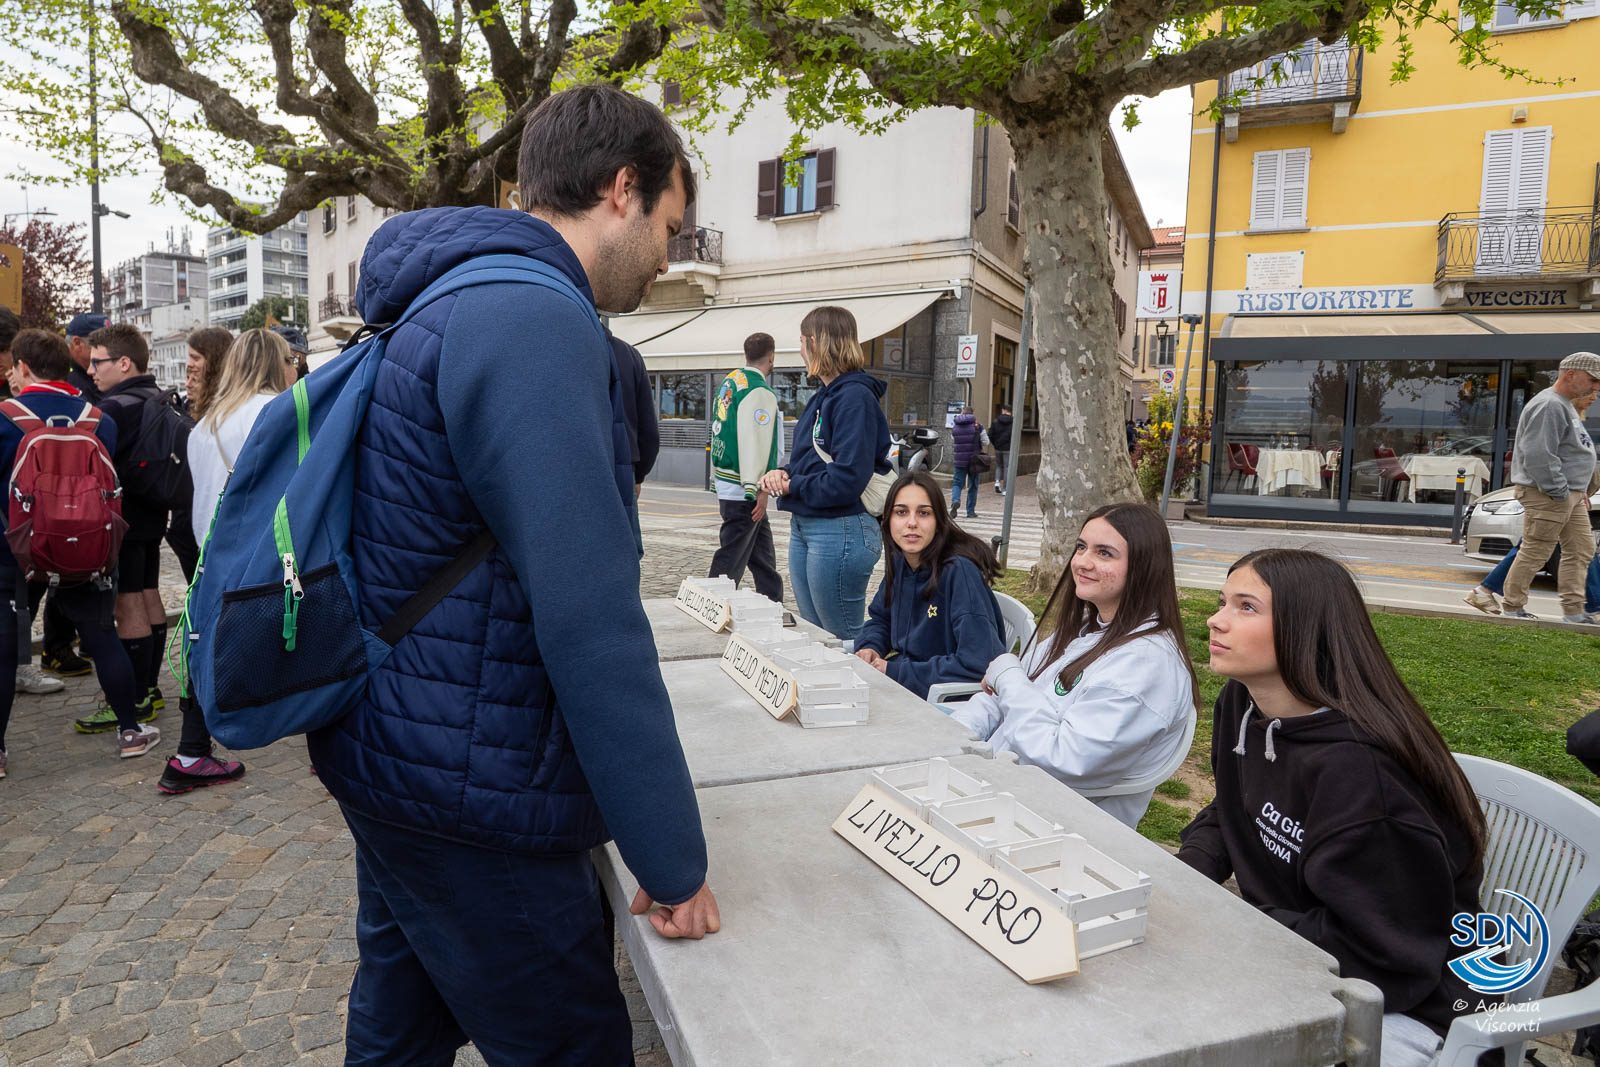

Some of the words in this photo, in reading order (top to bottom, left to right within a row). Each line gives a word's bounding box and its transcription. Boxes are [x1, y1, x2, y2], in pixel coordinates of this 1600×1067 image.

[1237, 289, 1414, 312] RISTORANTE
[1465, 290, 1567, 306] VECCHIA
[678, 585, 704, 613] LIVELLO
[724, 640, 758, 679] LIVELLO
[755, 666, 789, 708] MEDIO
[847, 799, 960, 887] LIVELLO
[965, 878, 1042, 945] PRO
